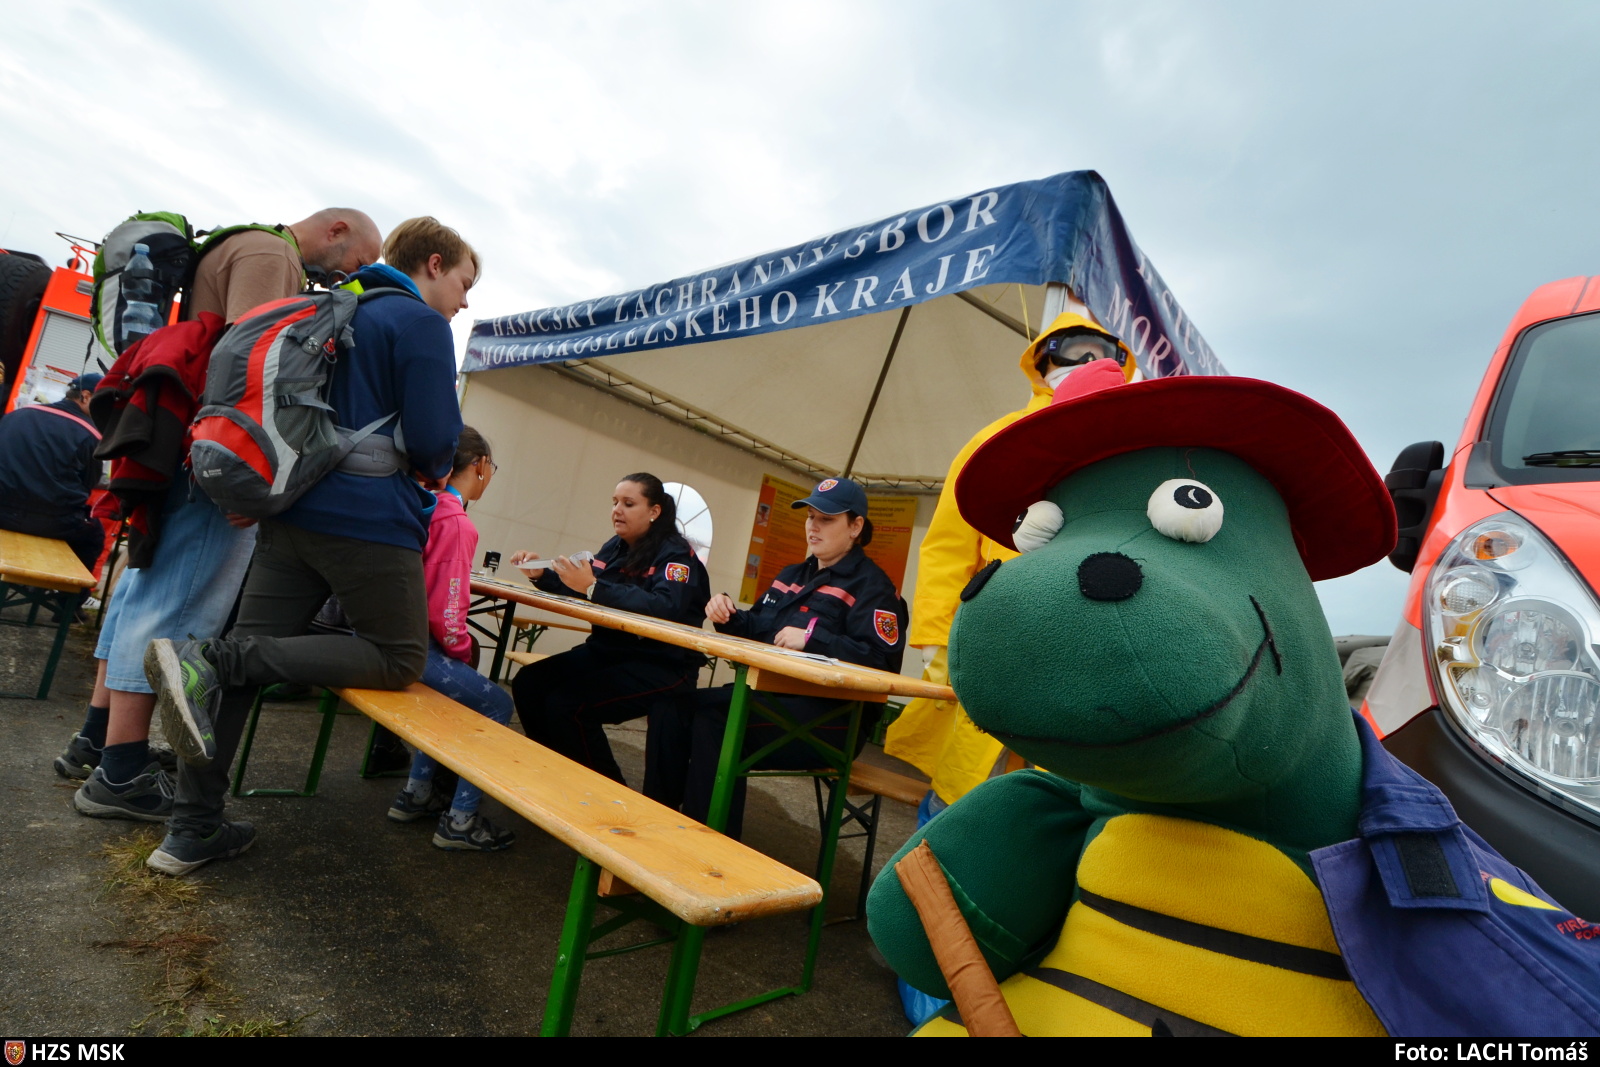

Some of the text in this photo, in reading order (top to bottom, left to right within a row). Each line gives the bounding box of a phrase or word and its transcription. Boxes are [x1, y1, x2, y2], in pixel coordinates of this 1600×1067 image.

[844, 191, 999, 260] SBOR
[811, 244, 996, 318] KRAJE
[1556, 917, 1590, 935] FIRE
